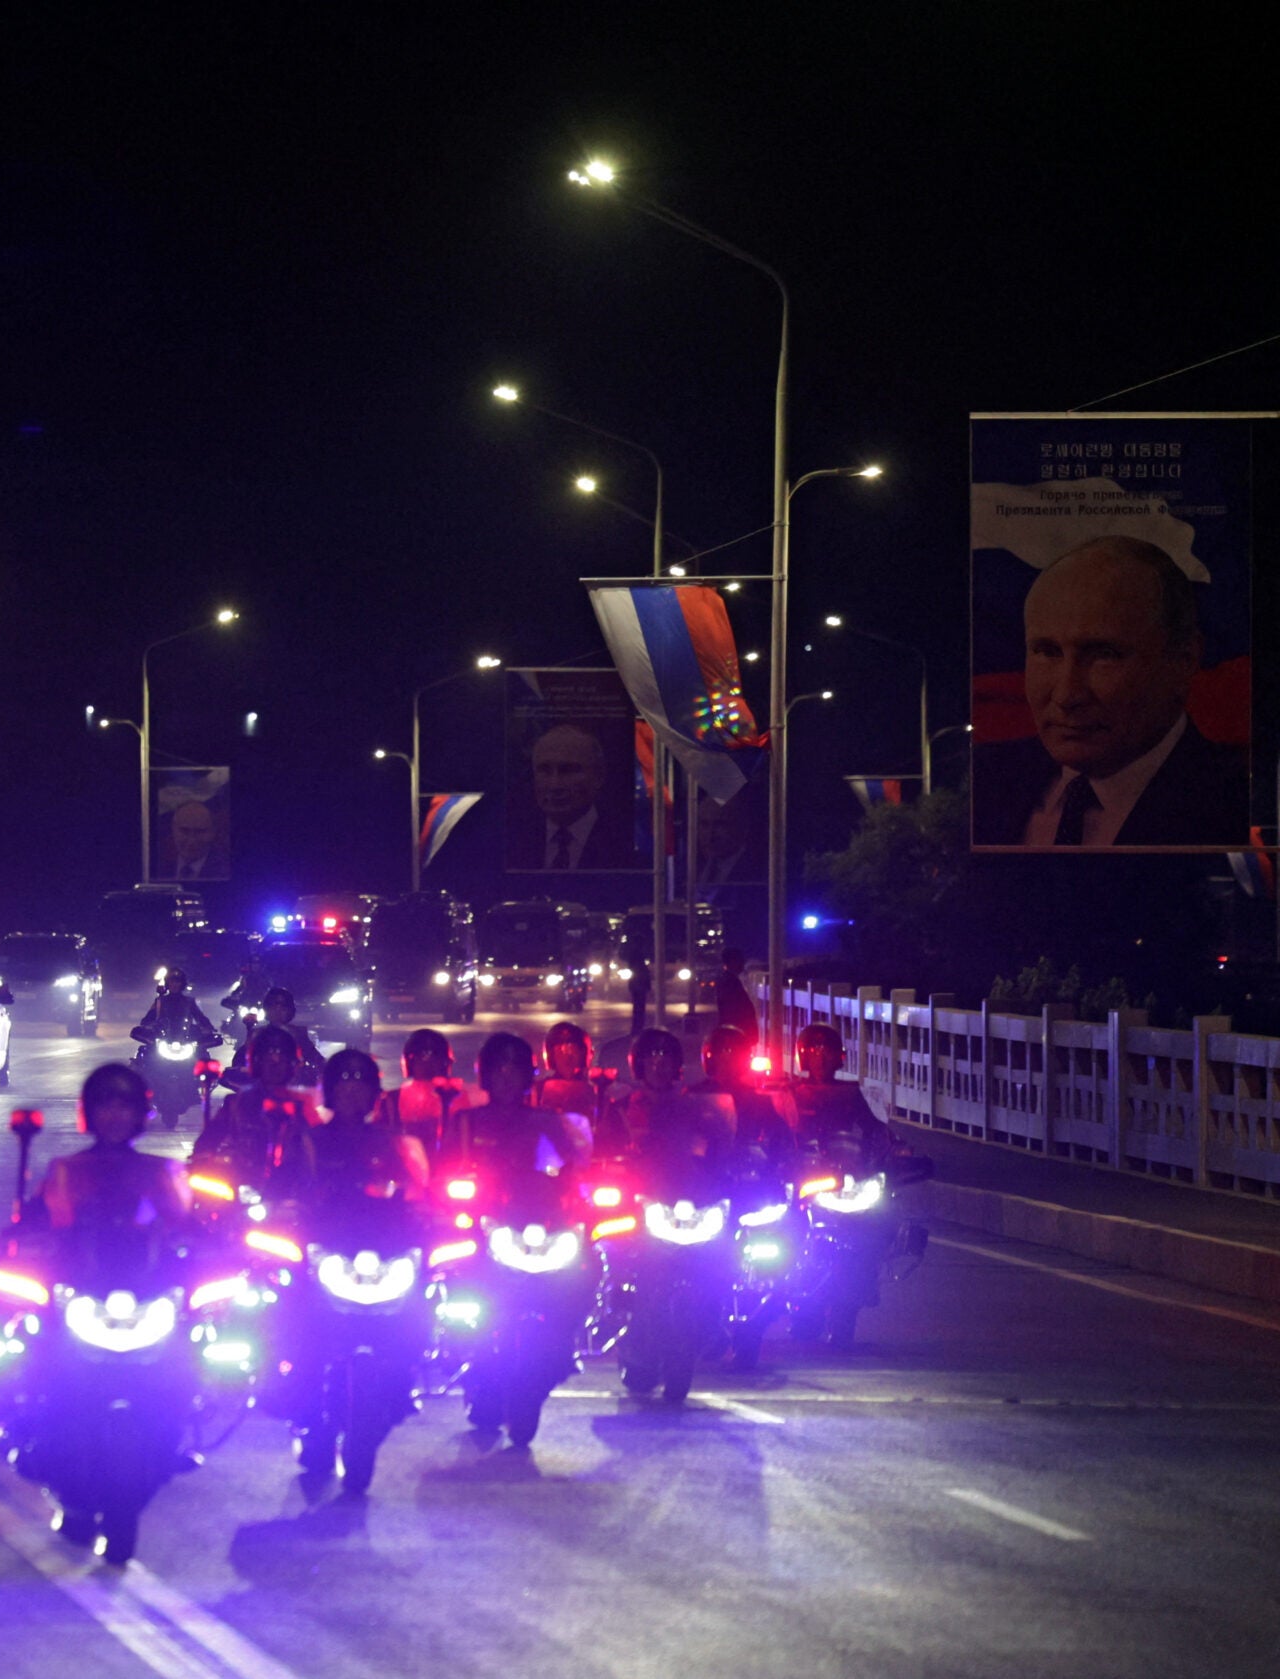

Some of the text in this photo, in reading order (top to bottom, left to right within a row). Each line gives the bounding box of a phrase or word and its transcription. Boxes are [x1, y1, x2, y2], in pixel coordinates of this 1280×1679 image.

[1100, 463, 1182, 478] 환영합니다
[1040, 489, 1087, 502] Горячо
[996, 504, 1071, 517] Президента
[1078, 503, 1151, 516] Российской
